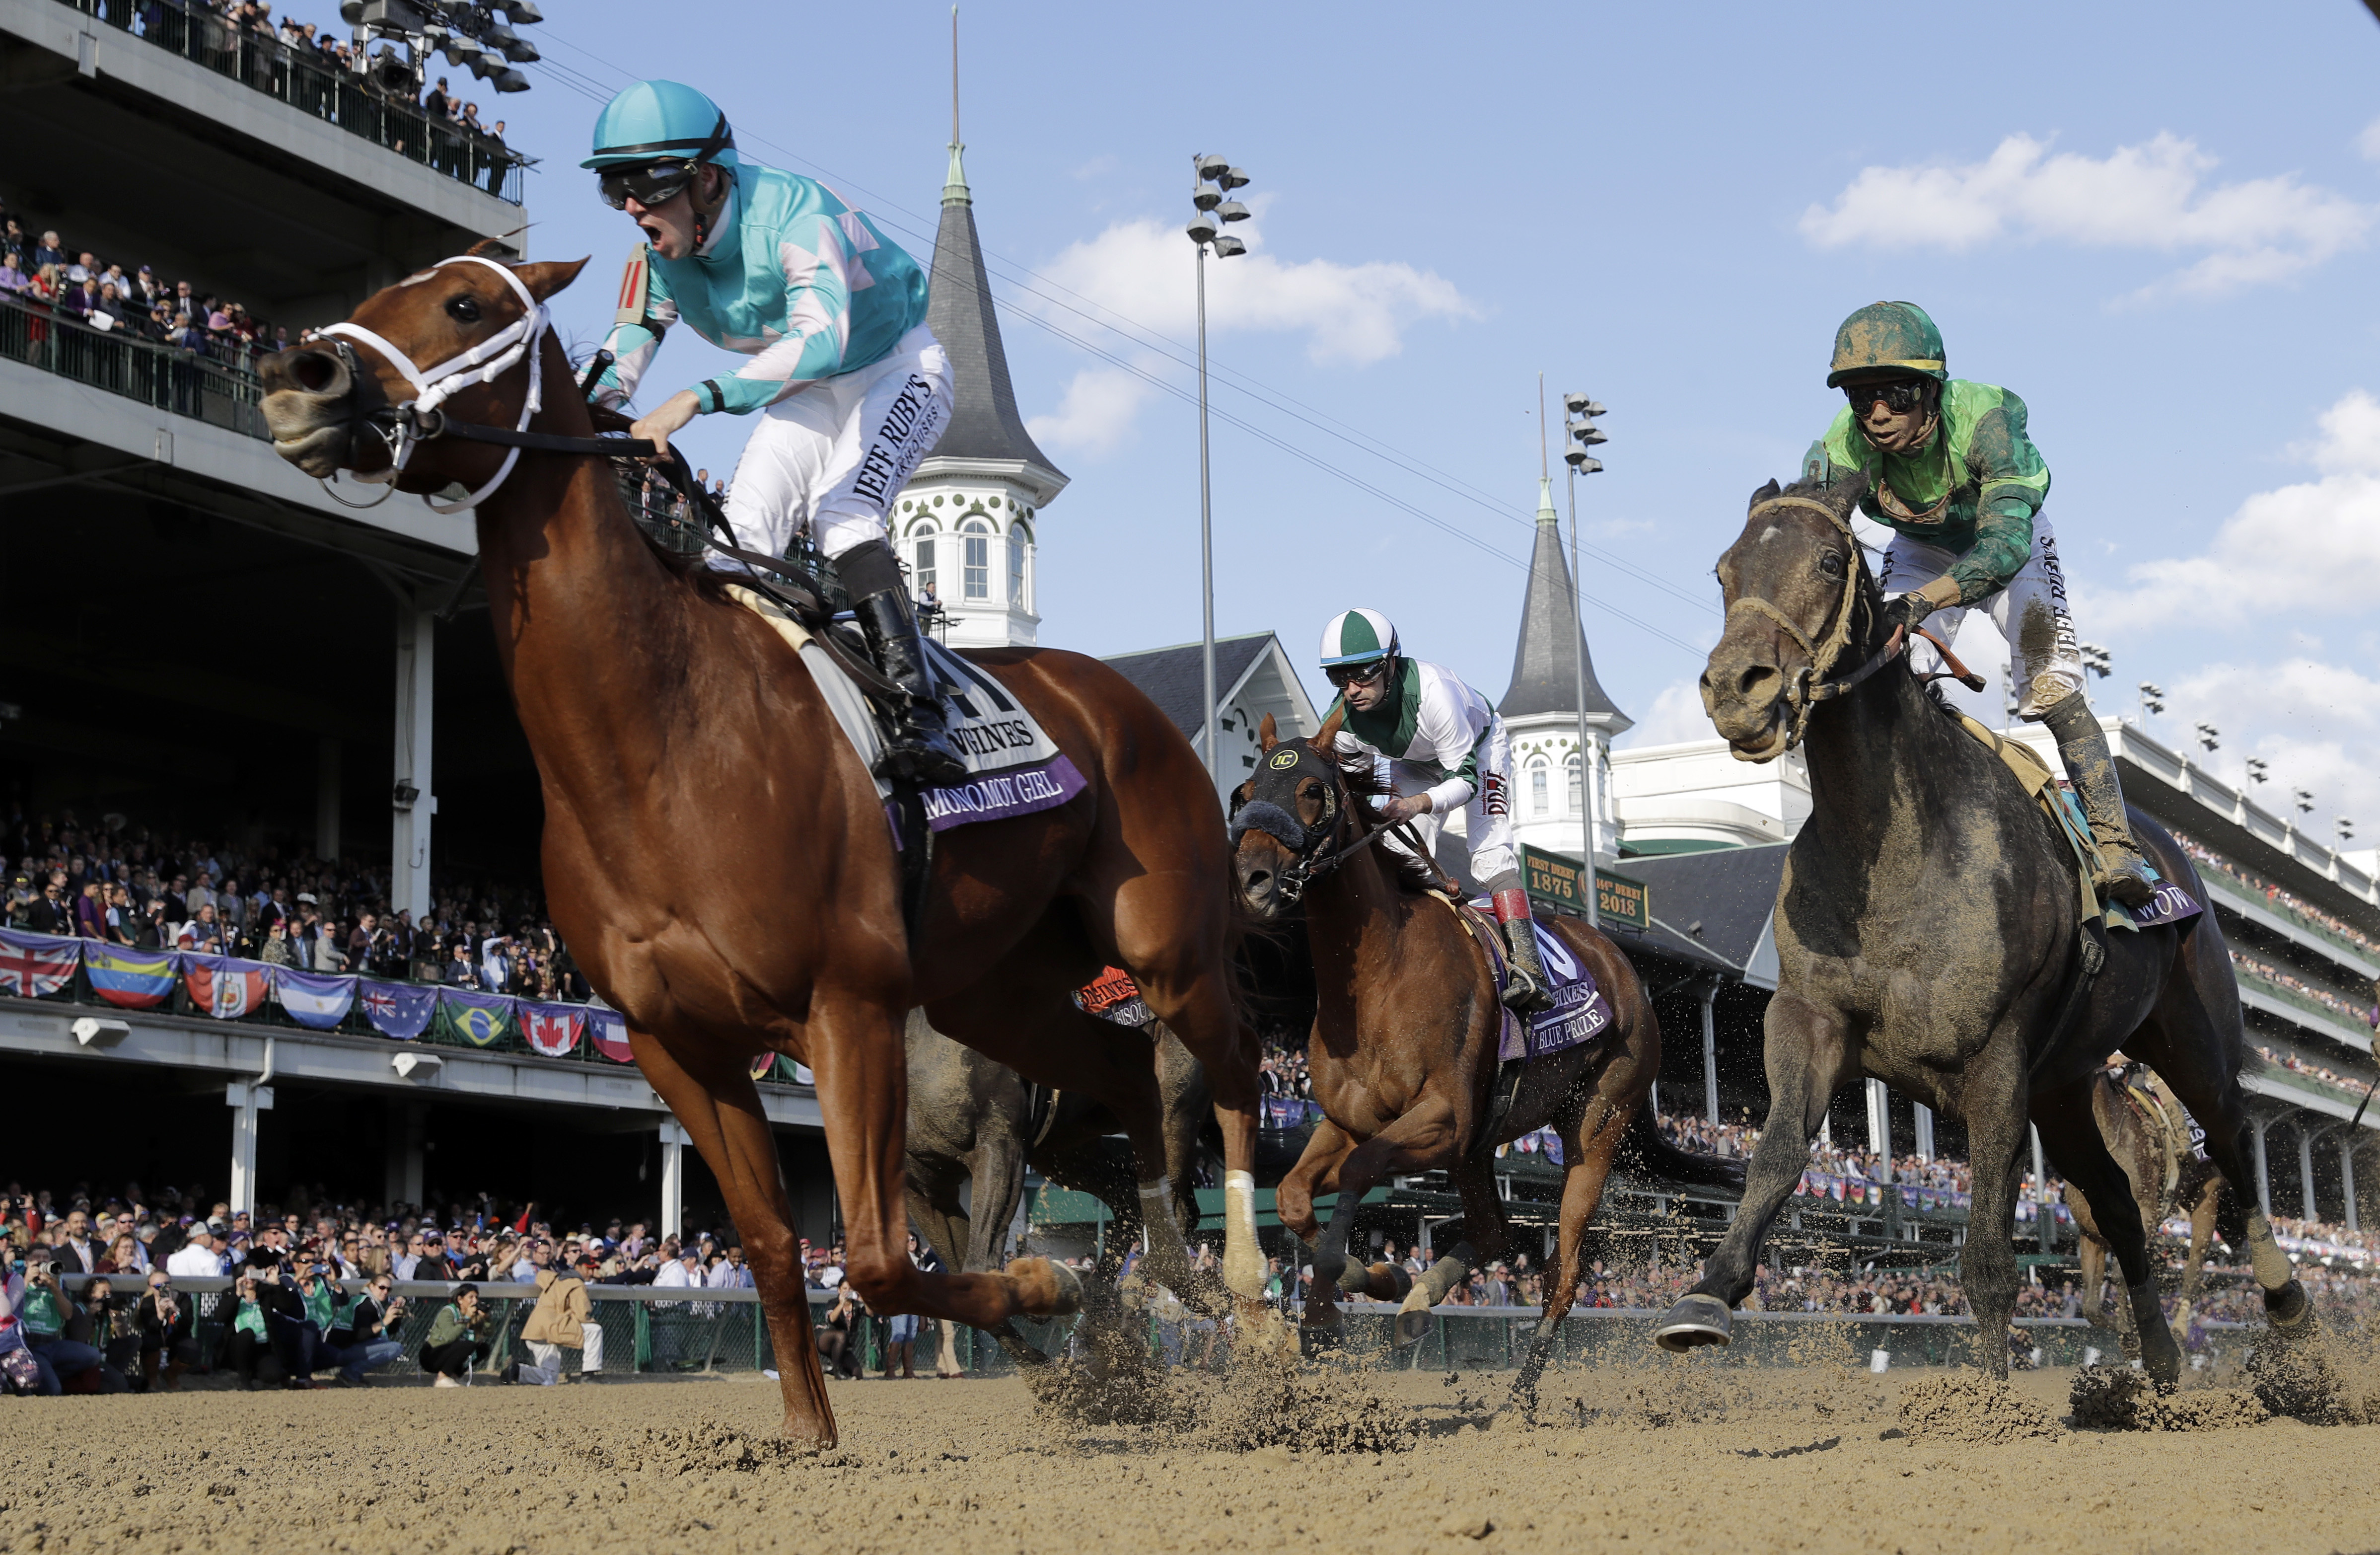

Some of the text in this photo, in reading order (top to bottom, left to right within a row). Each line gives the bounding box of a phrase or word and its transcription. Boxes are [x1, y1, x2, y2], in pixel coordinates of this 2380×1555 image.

[619, 261, 643, 308] 11
[854, 373, 932, 507] JEFF RUBY'S
[2053, 606, 2079, 656] JEFF
[1275, 754, 1293, 766] IC
[918, 771, 1064, 820] MONOMOY GIRL
[1526, 855, 1576, 881] FIRST DERBY
[1531, 871, 1573, 898] 1875
[1599, 892, 1636, 917] 2018
[1615, 883, 1642, 901] DERBY
[1538, 1009, 1605, 1050] BLUE PRIZE
